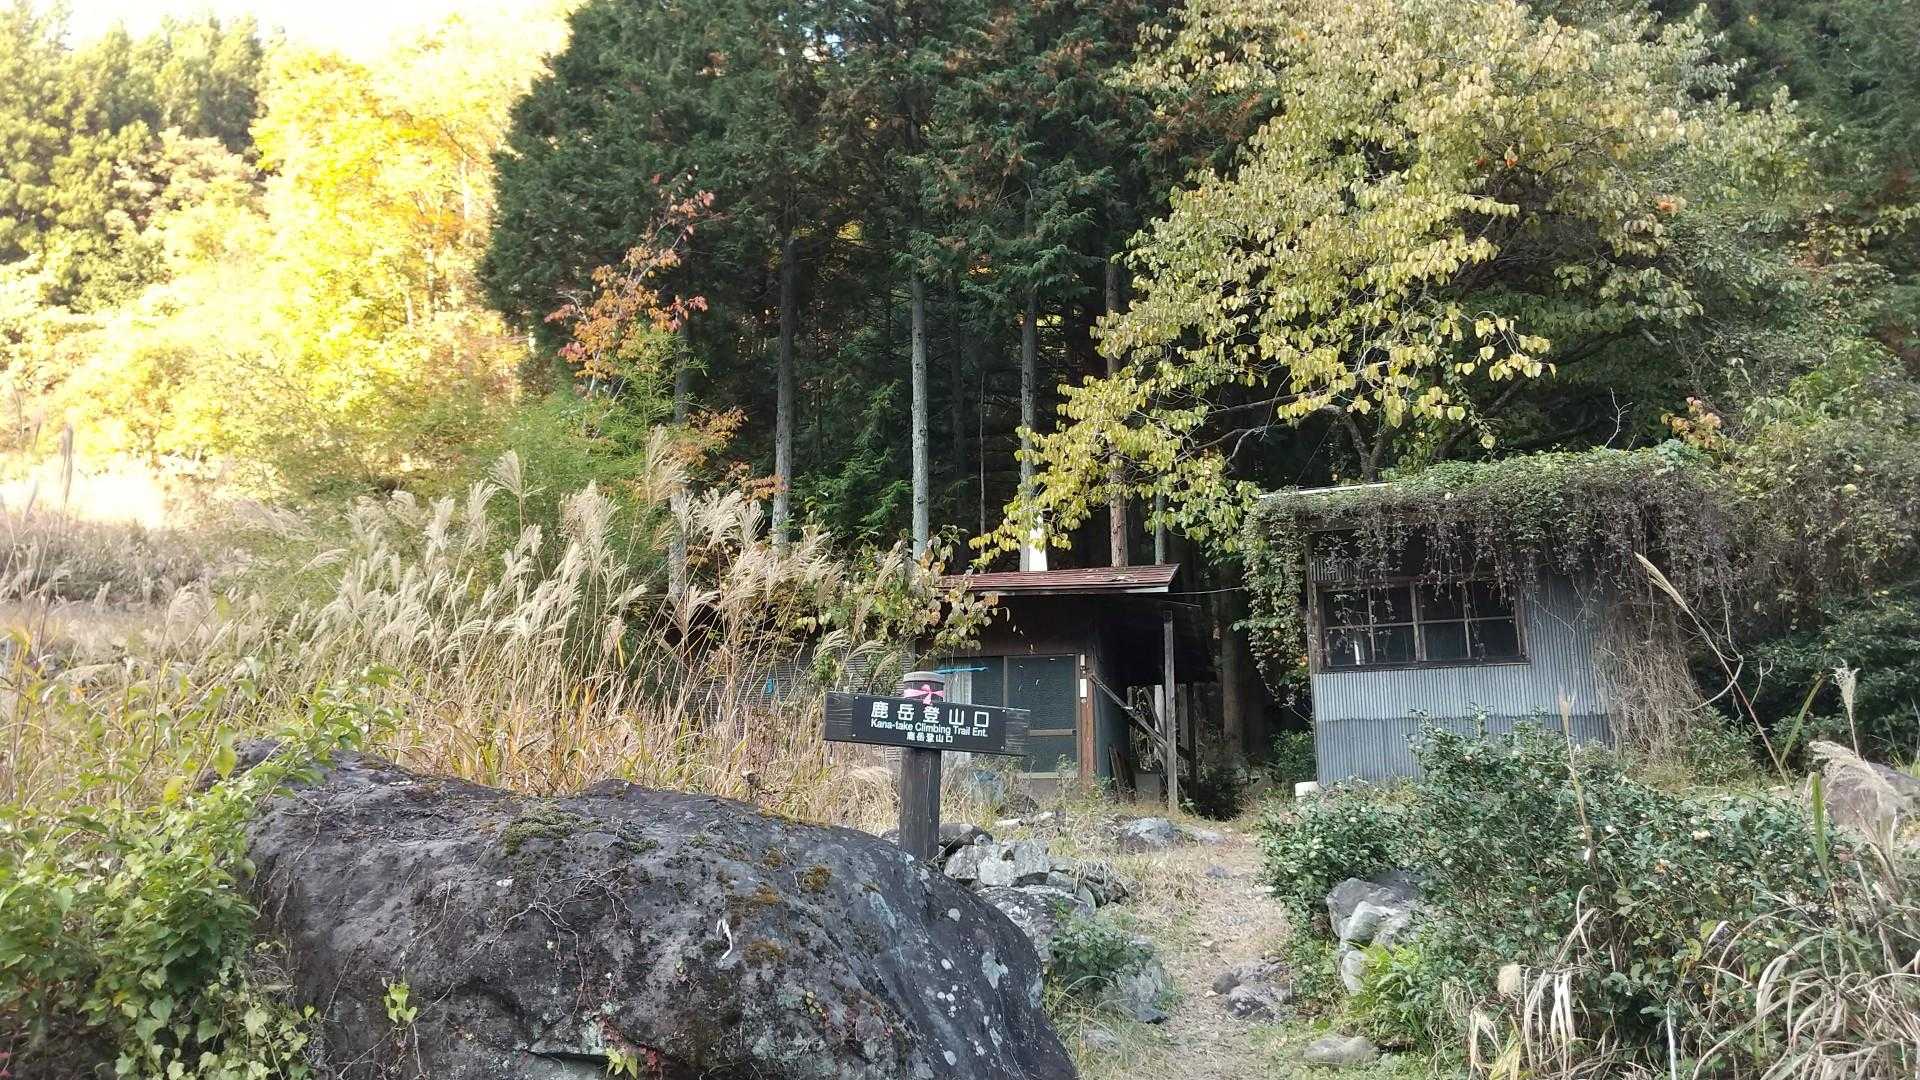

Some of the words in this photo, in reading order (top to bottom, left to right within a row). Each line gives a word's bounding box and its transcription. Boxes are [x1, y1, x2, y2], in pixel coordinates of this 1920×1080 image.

[870, 701, 989, 727] 鹿岳登山口
[870, 718, 914, 731] Kana-take
[915, 722, 951, 736] Climbing
[953, 725, 970, 736] Trail
[972, 727, 989, 737] Ent.
